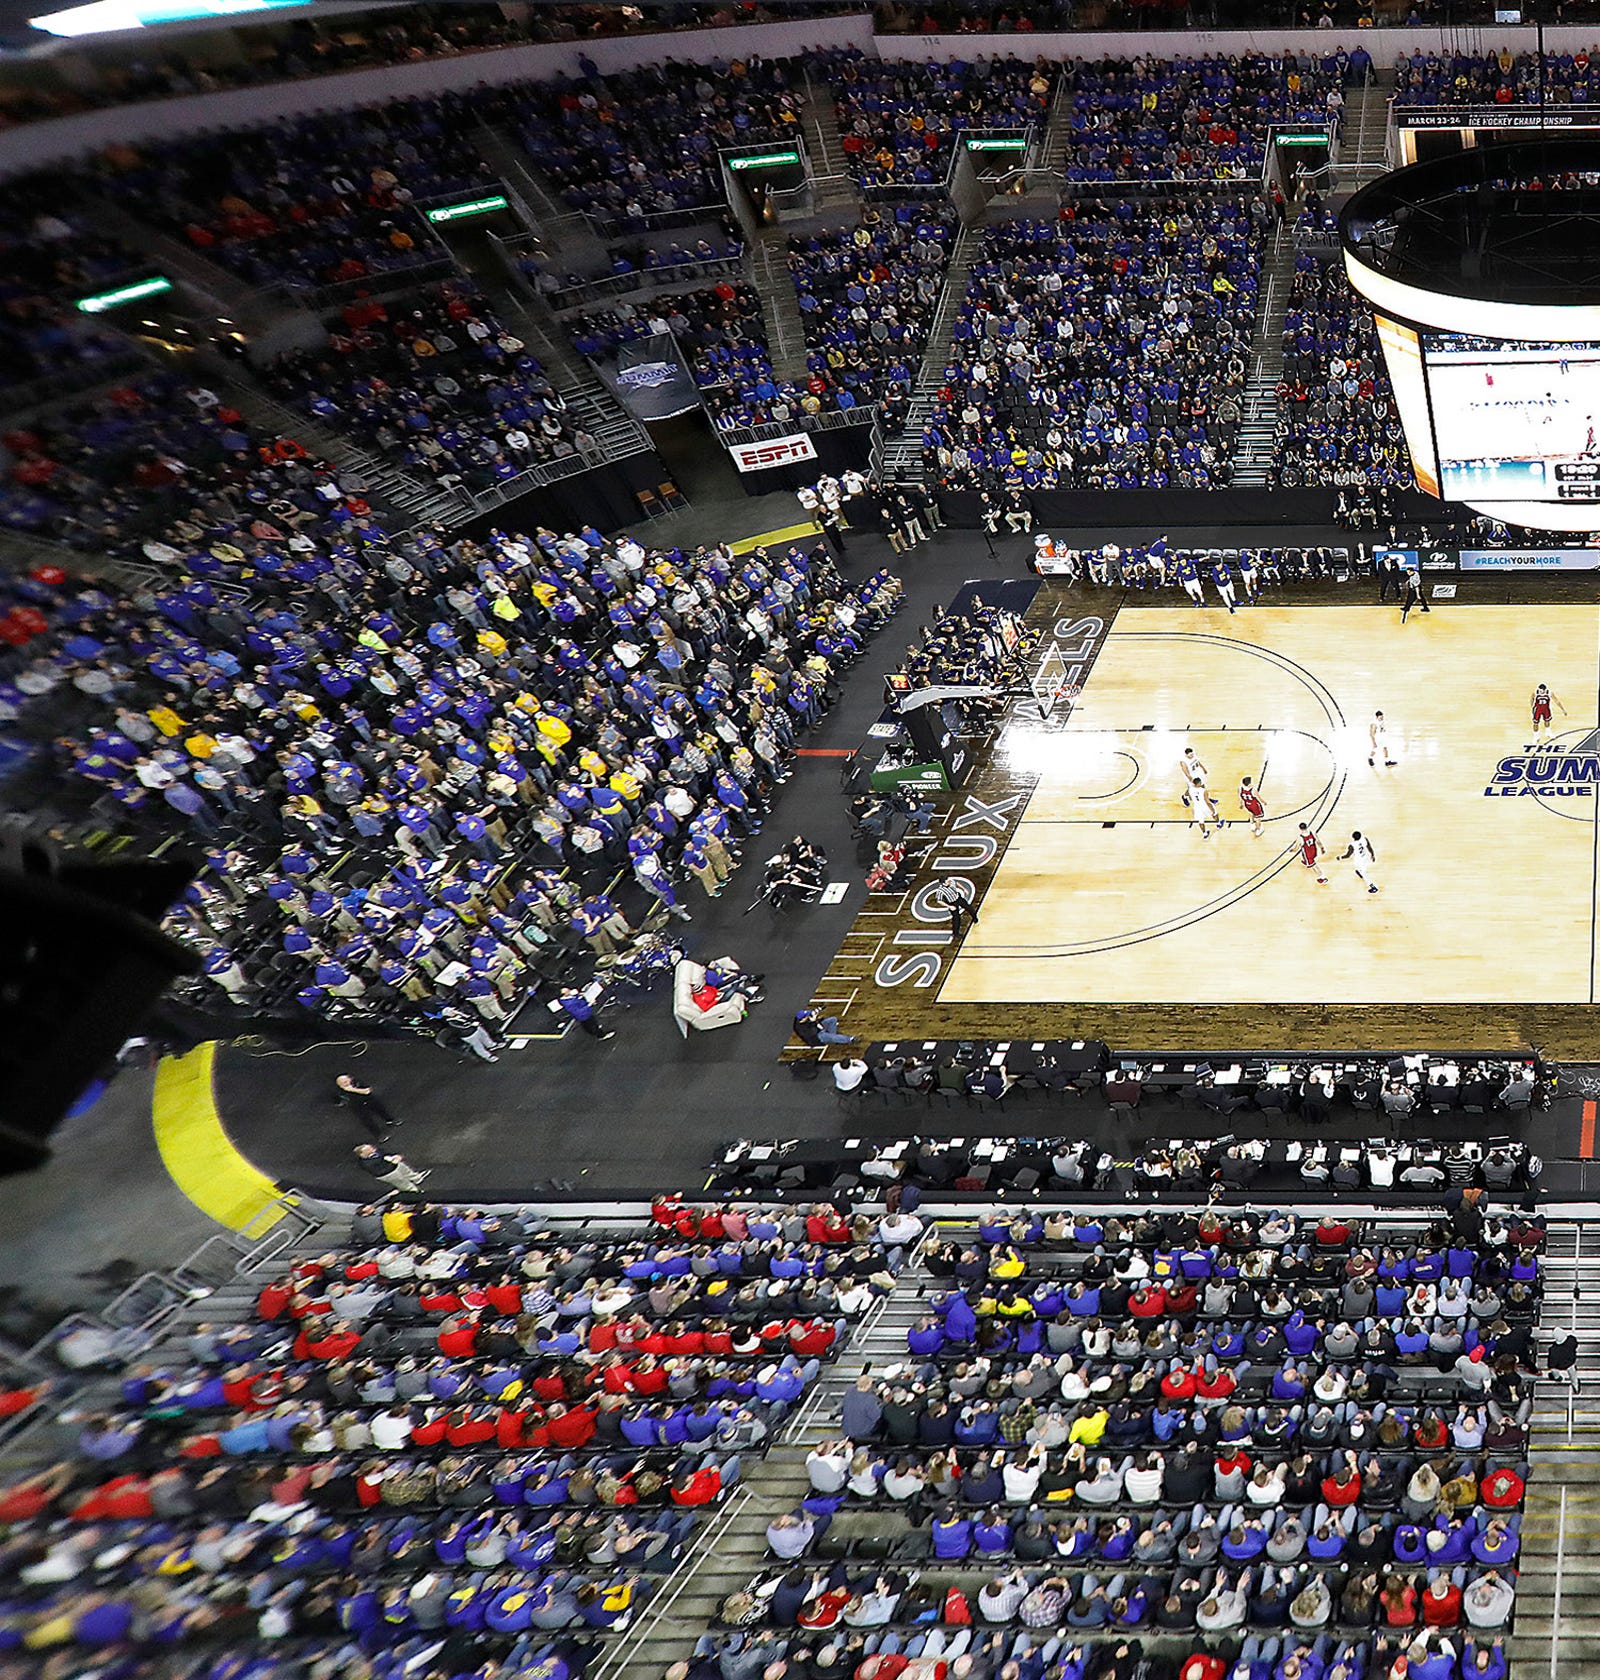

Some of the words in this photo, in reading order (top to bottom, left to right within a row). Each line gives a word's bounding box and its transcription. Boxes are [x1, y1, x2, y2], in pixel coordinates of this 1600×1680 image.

[921, 37, 940, 46] 114
[1407, 117, 1436, 125] MARCH
[1437, 116, 1461, 125] 23-24
[1468, 118, 1481, 126] ICE
[1482, 117, 1512, 126] HOCKEY
[1513, 116, 1573, 126] CHAMPONSHIP
[740, 440, 808, 466] ESPN
[1475, 556, 1561, 566] #REACHYOURMORE
[1522, 745, 1568, 753] THE
[1484, 786, 1592, 797] LEAGUE
[874, 794, 1022, 988] SIOUX
